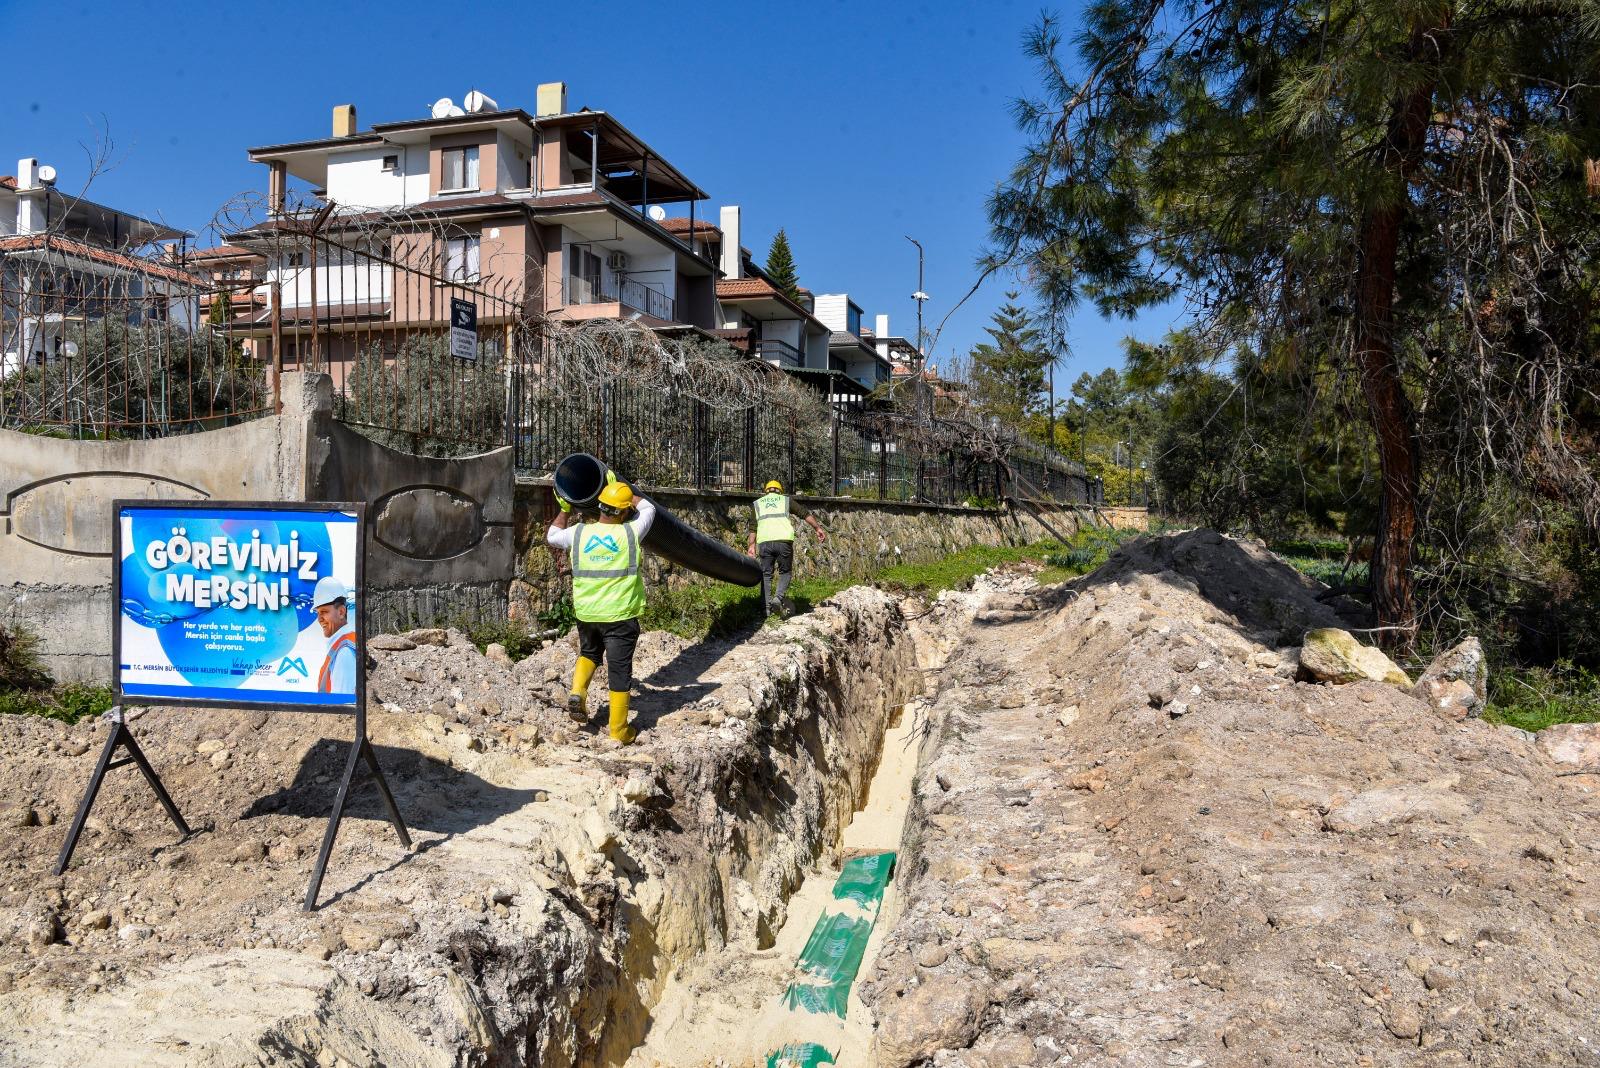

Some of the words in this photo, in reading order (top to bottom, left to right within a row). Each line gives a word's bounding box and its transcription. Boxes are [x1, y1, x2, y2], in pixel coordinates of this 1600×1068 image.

[146, 527, 318, 580] GÖREVİMİZ
[166, 573, 290, 610] MERSİN!
[183, 621, 196, 629] Her
[198, 622, 218, 631] yerde
[231, 623, 242, 631] her
[244, 624, 268, 633] şartta,
[185, 631, 208, 639] Mersin
[211, 632, 222, 641] için
[225, 633, 243, 641] canla
[246, 634, 265, 643] başla
[205, 642, 244, 651] çalışıyoruz.
[143, 664, 163, 672] MERSİN
[201, 666, 229, 674] BELEDİYESİ
